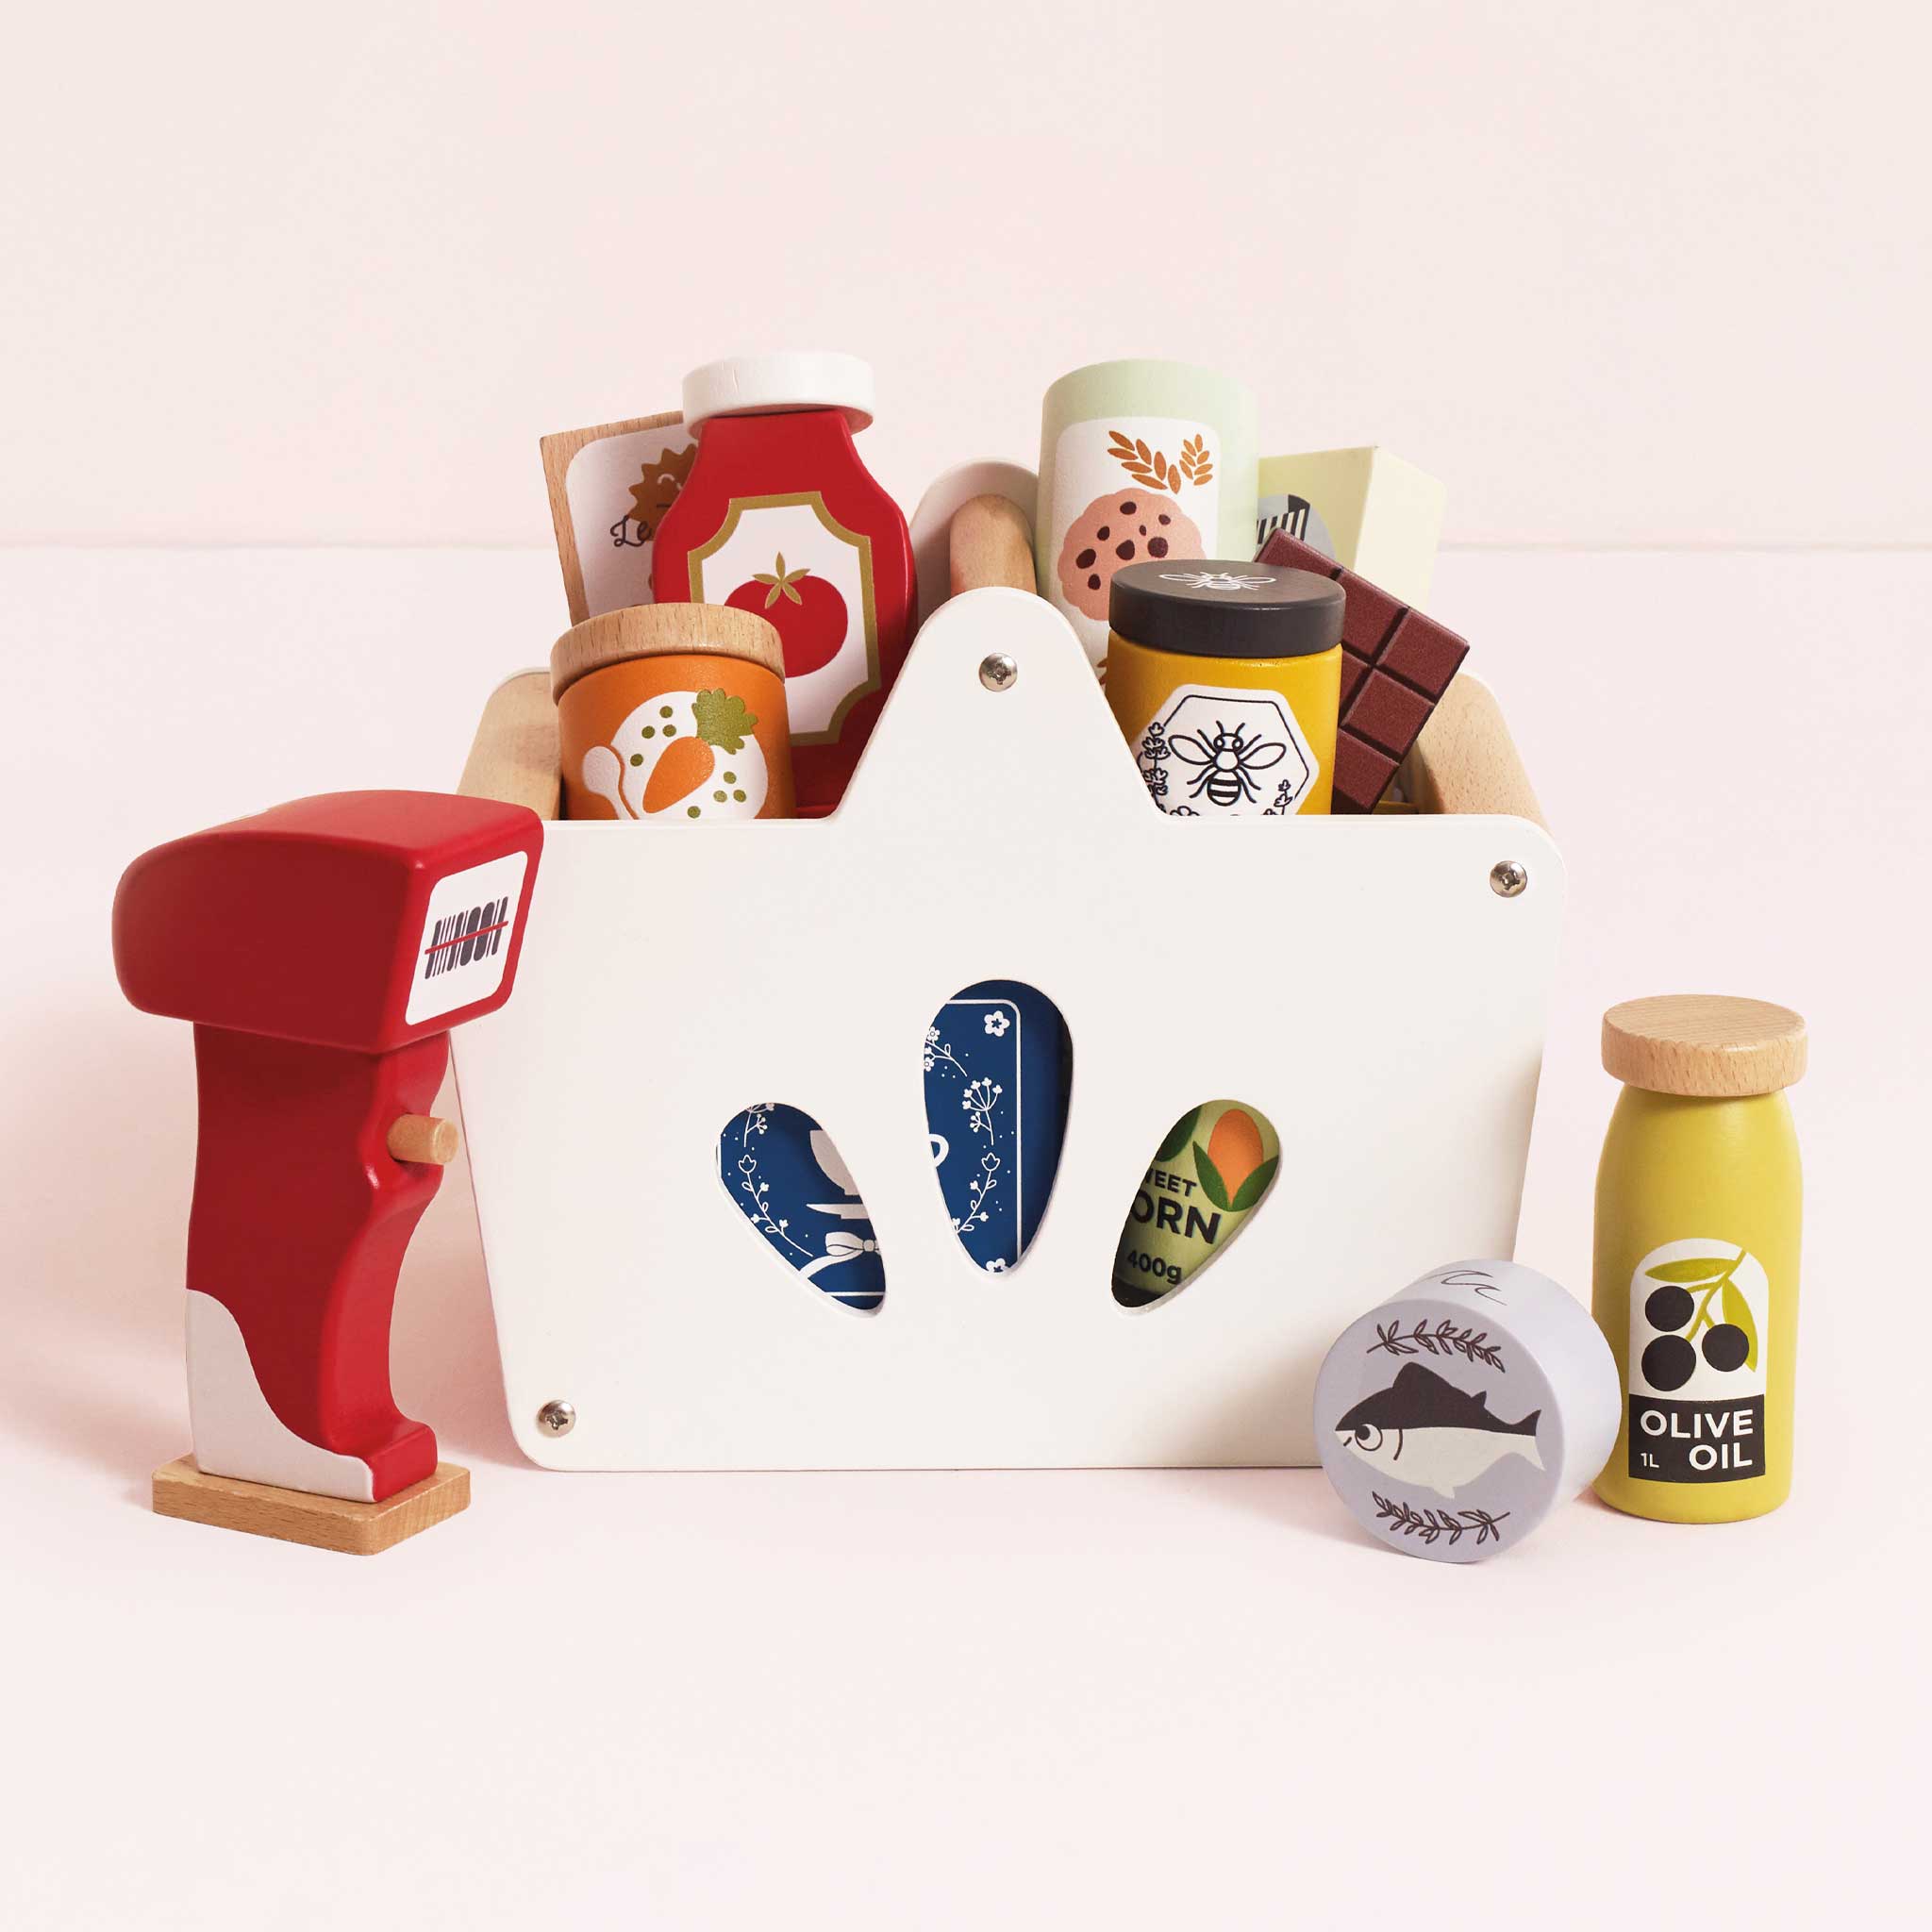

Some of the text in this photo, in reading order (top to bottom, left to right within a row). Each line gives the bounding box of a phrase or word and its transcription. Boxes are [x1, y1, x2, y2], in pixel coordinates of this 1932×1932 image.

[1126, 1250, 1181, 1286] 400g
[1640, 1408, 1754, 1439] OLIVE
[1641, 1452, 1660, 1469] 1L
[1689, 1441, 1753, 1471] OIL
